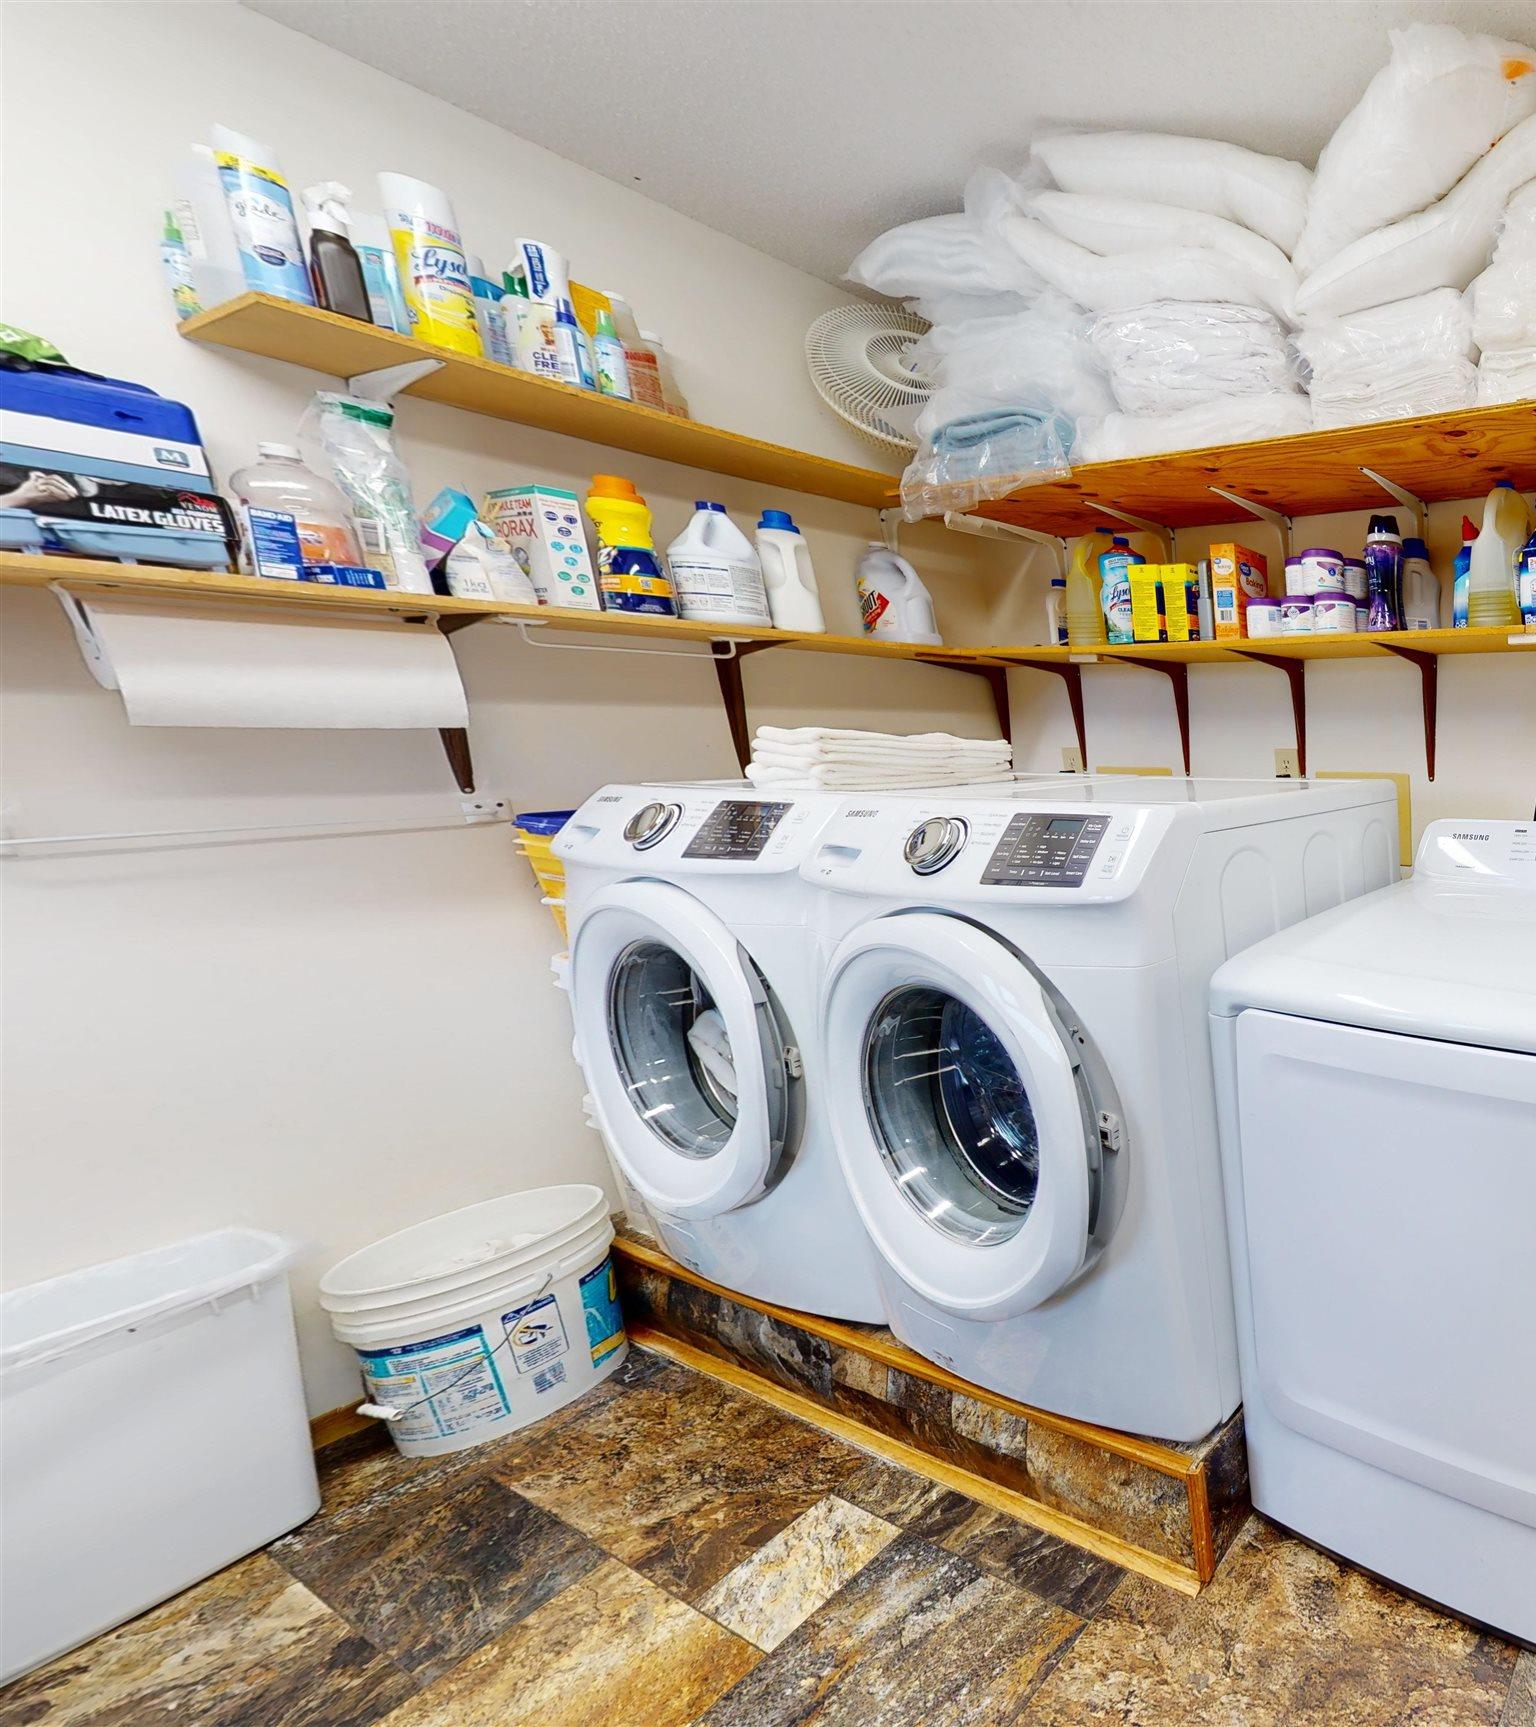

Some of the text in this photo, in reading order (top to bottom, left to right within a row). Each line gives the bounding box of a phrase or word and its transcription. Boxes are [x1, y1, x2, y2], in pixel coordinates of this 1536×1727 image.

[235, 201, 284, 221] gade
[532, 351, 558, 361] CLE
[534, 360, 560, 371] FRE
[160, 450, 183, 462] M
[513, 498, 532, 509] TEAM
[90, 502, 152, 523] LATEX
[155, 510, 225, 532] GLOVES
[250, 508, 294, 523] BAND-AID
[1245, 577, 1264, 592] Baking
[1110, 586, 1131, 602] Lyso
[845, 810, 879, 818] SAMSUNG
[1452, 832, 1490, 842] SAMSUNG
